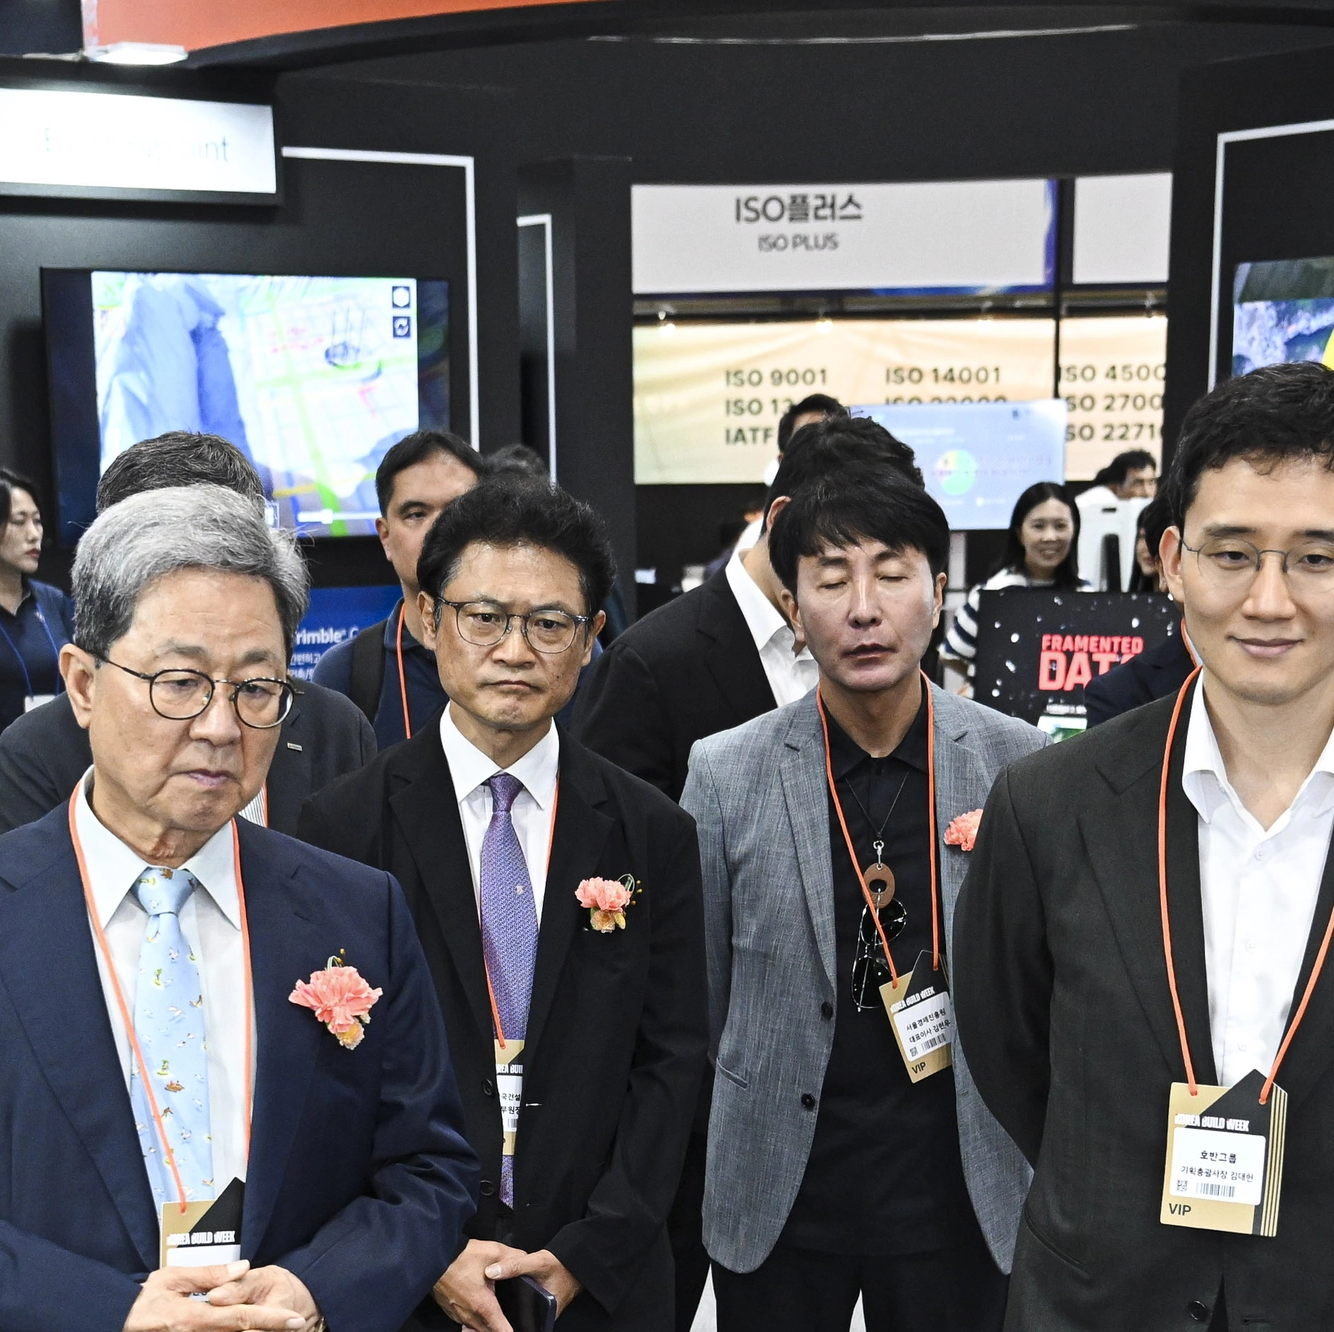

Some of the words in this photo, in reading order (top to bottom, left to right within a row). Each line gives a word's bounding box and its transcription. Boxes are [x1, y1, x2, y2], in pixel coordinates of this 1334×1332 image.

[735, 194, 863, 224] ISO플러스
[758, 234, 788, 251] ISO
[792, 233, 839, 251] PLUS
[726, 369, 763, 387] ISO
[770, 368, 827, 386] 9001
[886, 367, 923, 385] ISO
[932, 367, 1001, 385] 14001
[1065, 364, 1096, 382] SO
[1105, 364, 1165, 382] 4500
[726, 398, 763, 416] ISO
[1066, 394, 1096, 412] SO
[1104, 394, 1163, 412] 2700
[726, 427, 773, 445] IATF
[1066, 423, 1095, 442] SO
[1104, 423, 1157, 441] 2271
[295, 627, 343, 645] rimble
[1041, 634, 1145, 654] FRAMENTED
[906, 1007, 947, 1031] 서울경제진흥원
[909, 1028, 932, 1043] 대표이사
[911, 1061, 926, 1074] VIP
[1201, 1116, 1225, 1129] BUILD
[1226, 1119, 1250, 1132] WEEK
[1200, 1150, 1237, 1164] 호반그룹
[1169, 1202, 1192, 1216] VIP
[191, 1231, 213, 1245] BUILD
[214, 1230, 235, 1243] WEEK
